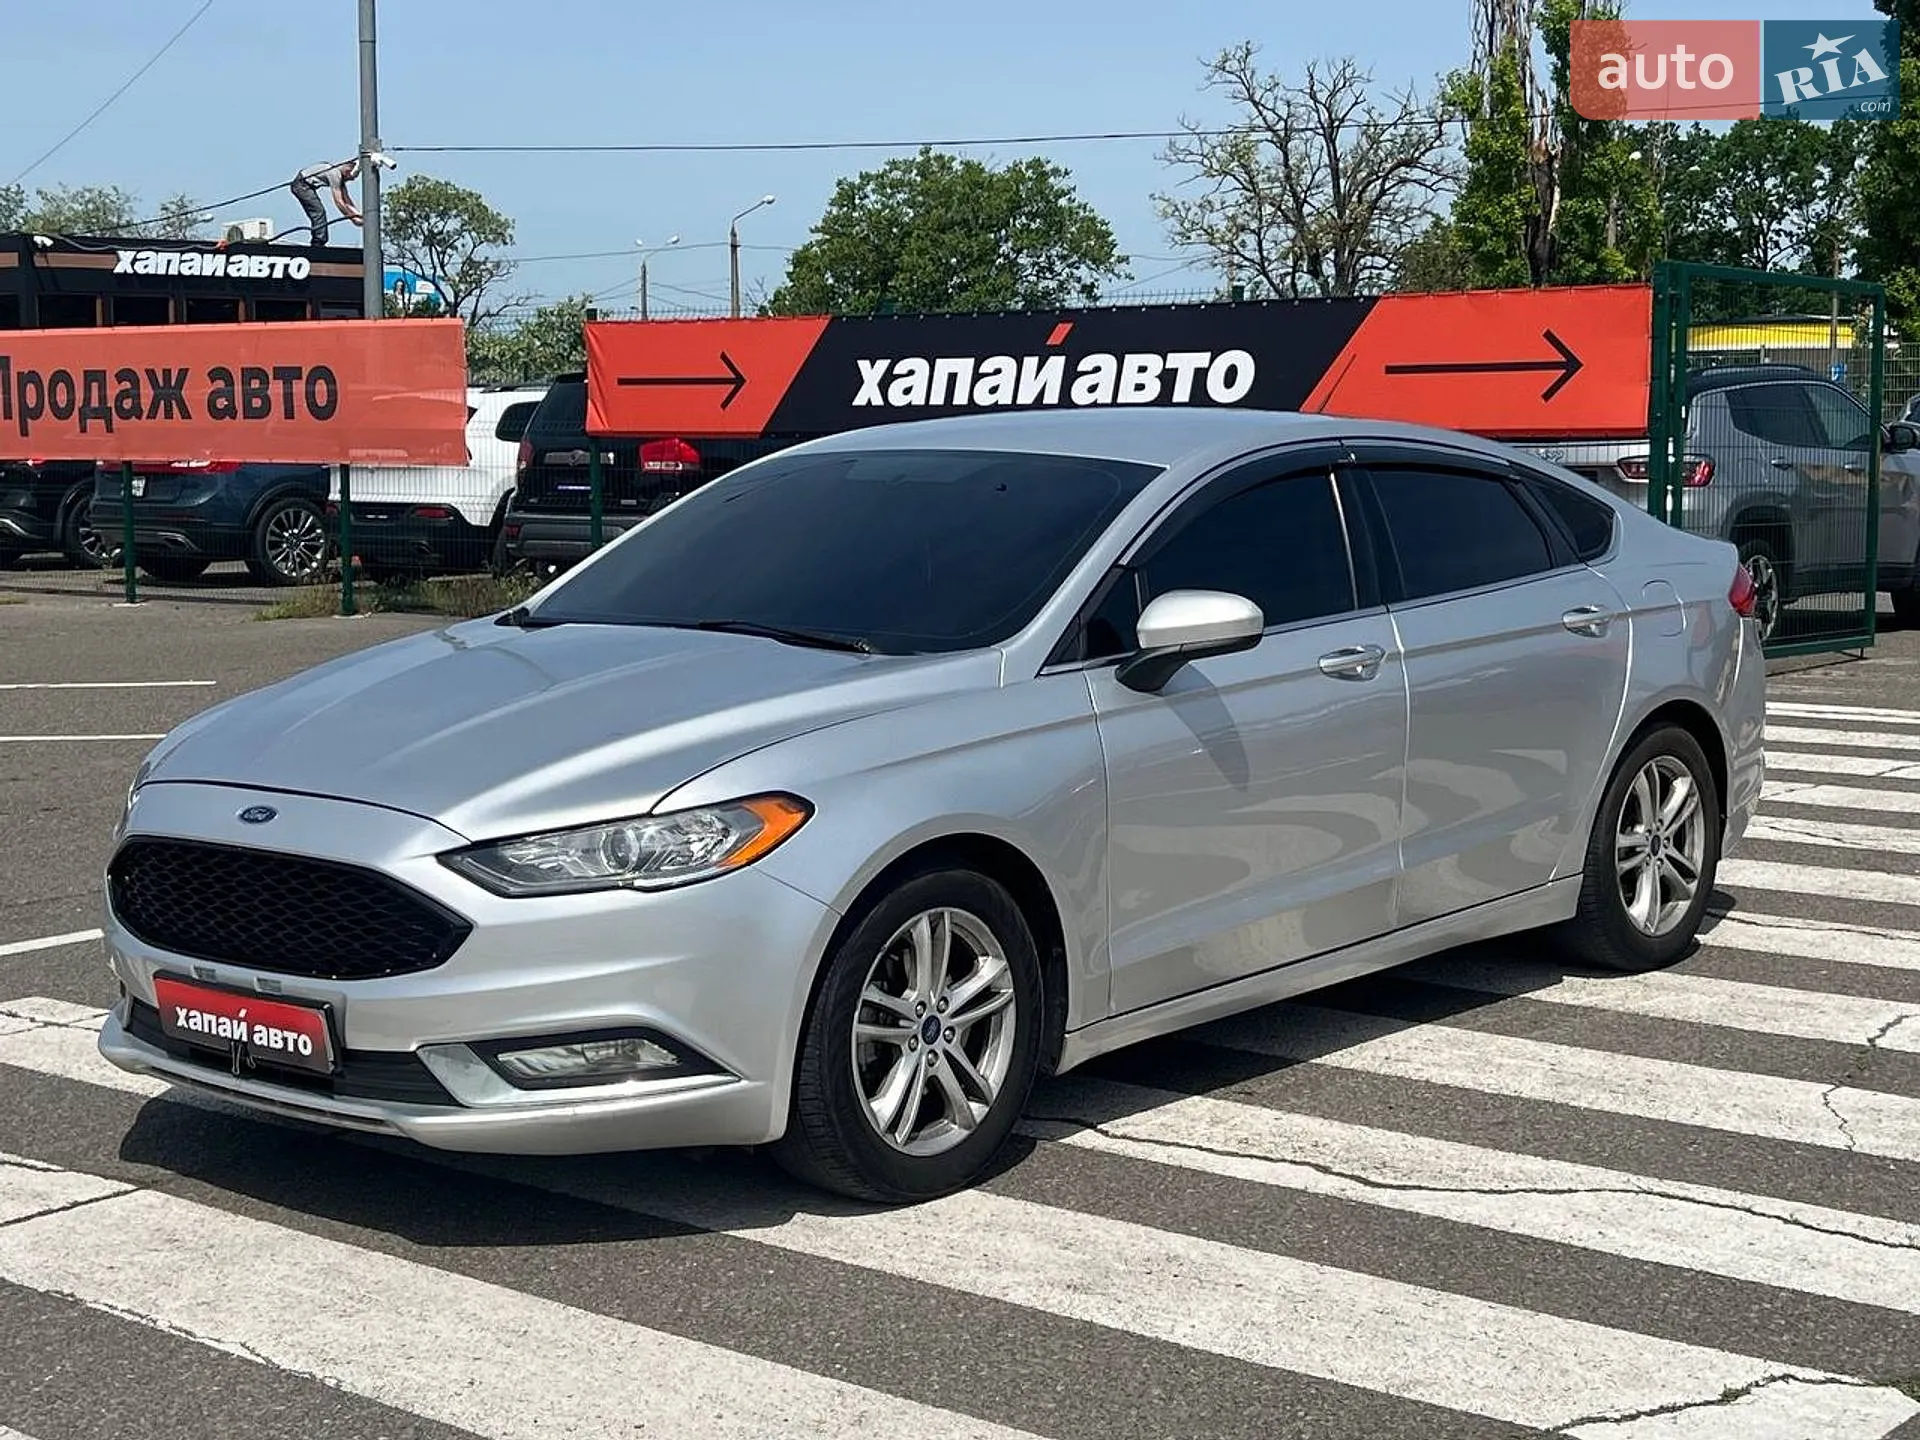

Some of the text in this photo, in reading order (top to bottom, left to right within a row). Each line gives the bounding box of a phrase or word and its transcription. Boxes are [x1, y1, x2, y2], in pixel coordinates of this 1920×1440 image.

[207, 364, 338, 421] авто
[175, 1006, 313, 1056] хапай авто
